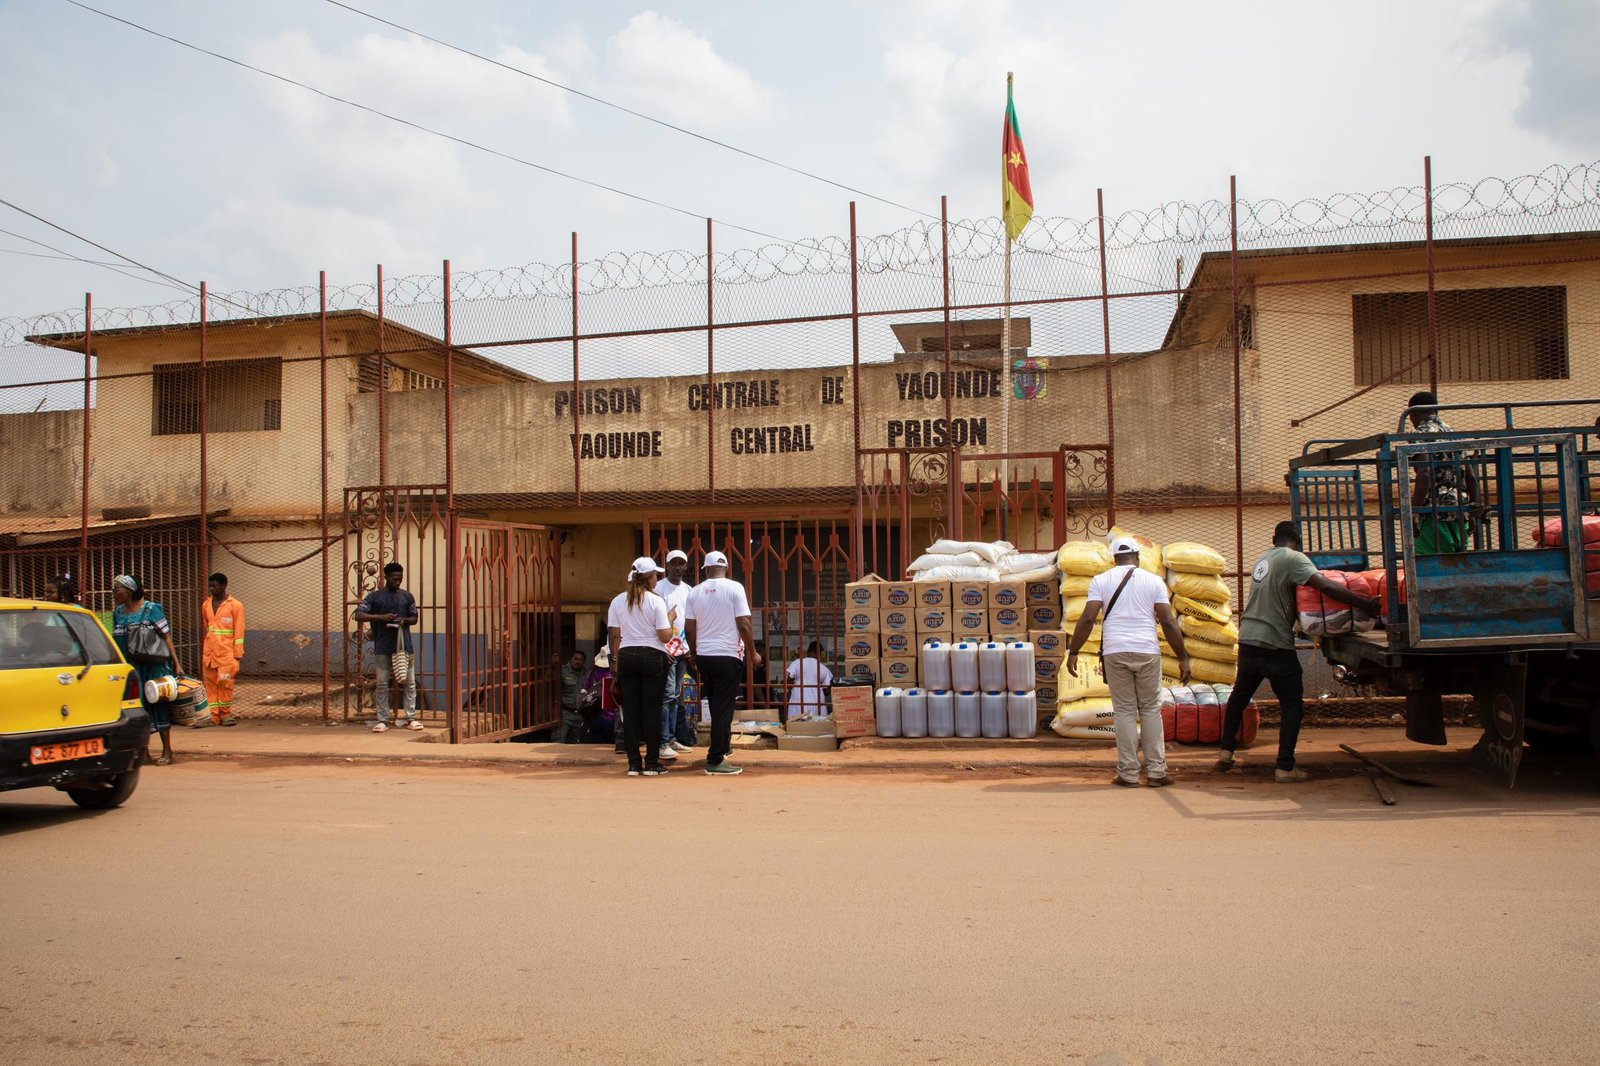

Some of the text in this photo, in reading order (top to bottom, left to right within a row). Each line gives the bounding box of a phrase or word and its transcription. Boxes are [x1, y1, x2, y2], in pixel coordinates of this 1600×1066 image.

[555, 369, 1002, 416] PRISON CENTRALE DE YAOUNDE
[570, 417, 987, 460] YAOUNDE CENTRAL PRISON
